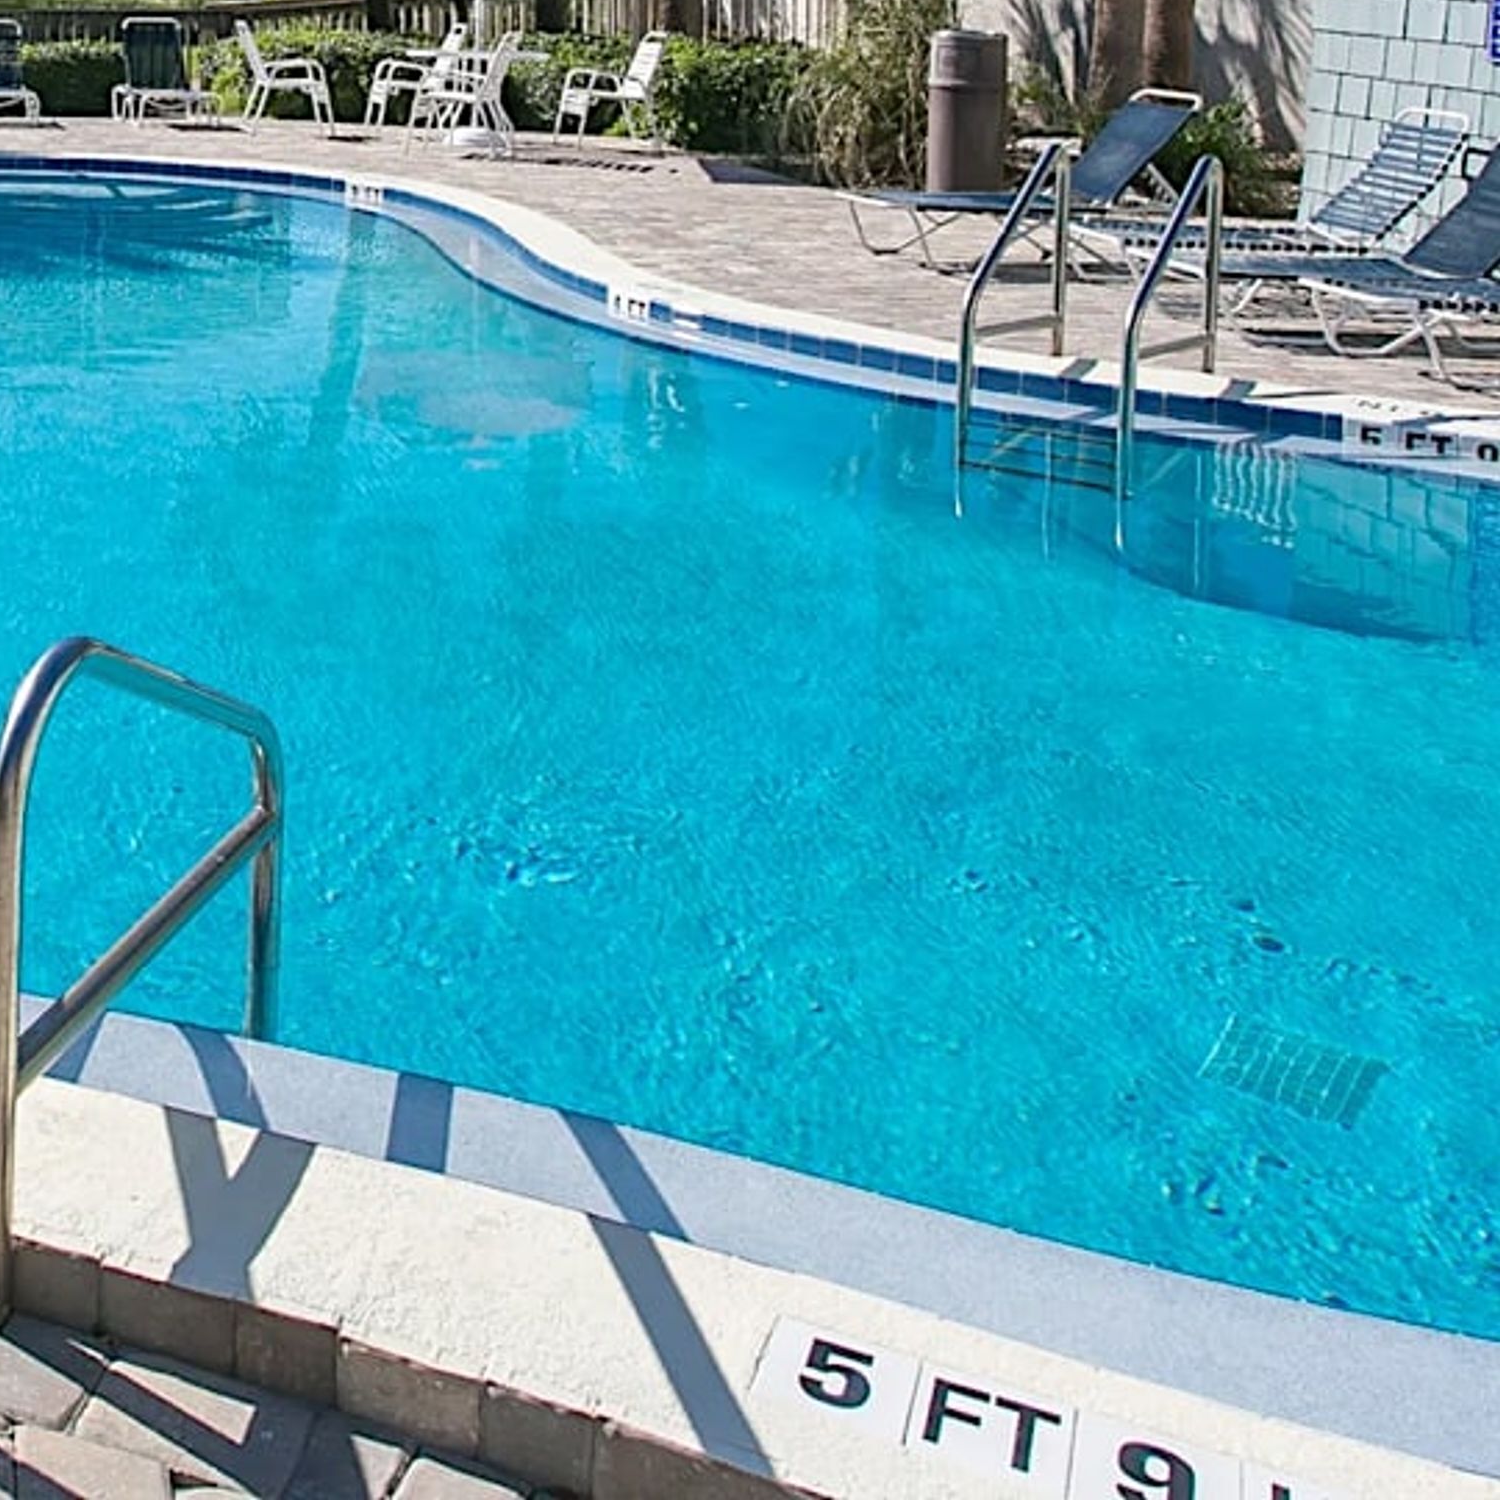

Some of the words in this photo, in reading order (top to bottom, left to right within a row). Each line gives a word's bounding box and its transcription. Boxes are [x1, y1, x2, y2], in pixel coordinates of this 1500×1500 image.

[798, 1336, 875, 1410] 5
[921, 1376, 1062, 1474] FT
[1115, 1441, 1196, 1500] 9
